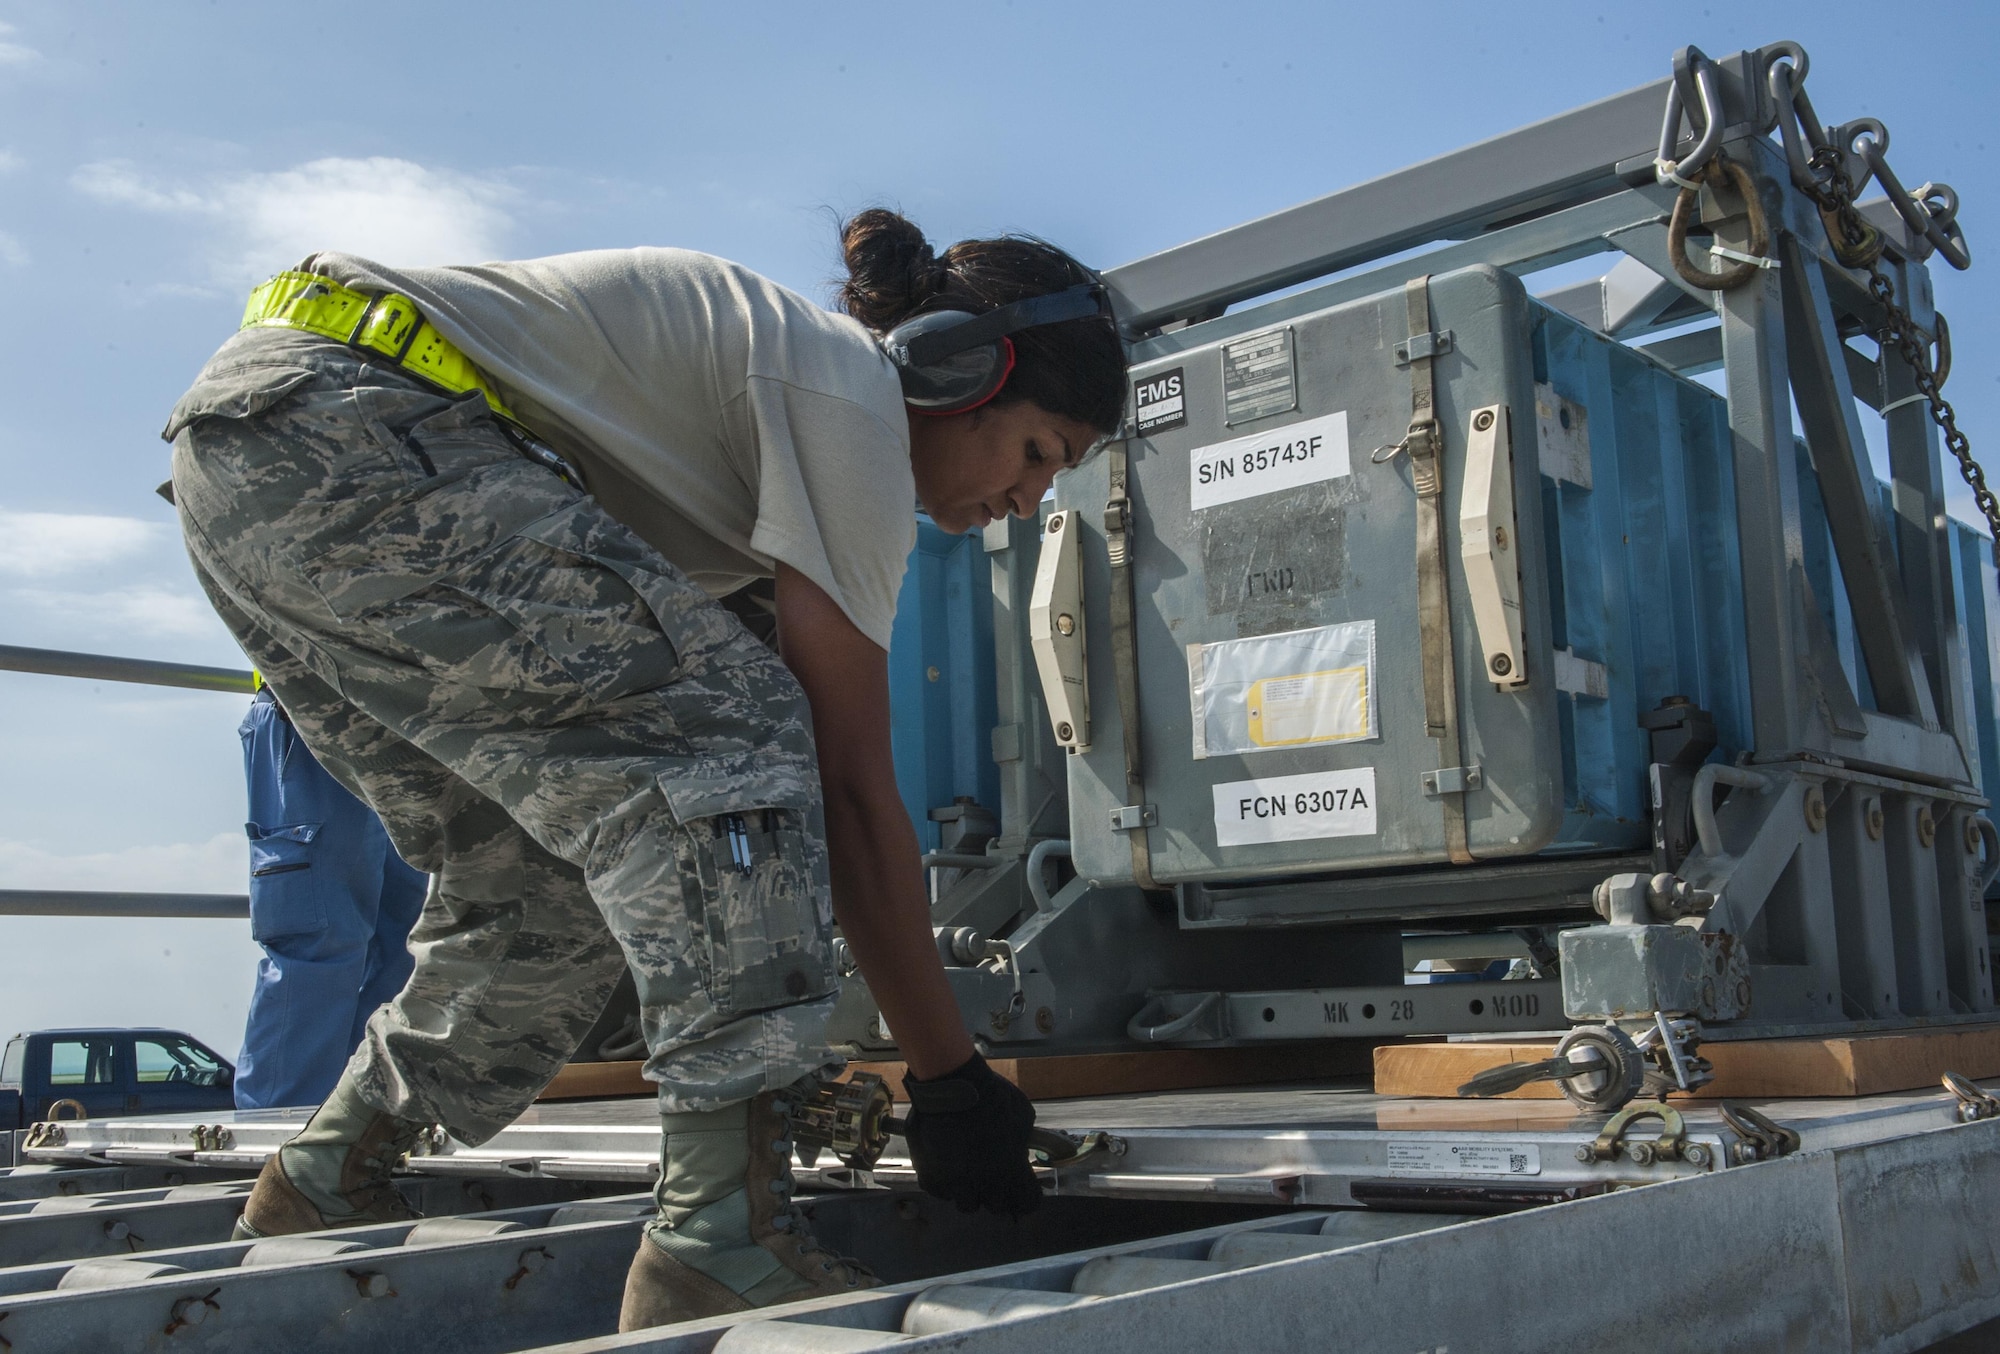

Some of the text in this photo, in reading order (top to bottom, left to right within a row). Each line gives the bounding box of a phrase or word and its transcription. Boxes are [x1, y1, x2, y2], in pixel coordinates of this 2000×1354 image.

[1137, 375, 1181, 406] FMS
[1138, 411, 1184, 430] CASE NUMBER
[1198, 435, 1322, 485] S/N 85743F
[1248, 567, 1294, 597] FWD
[1239, 787, 1369, 820] FCN 6307A
[1323, 993, 1540, 1024] MK 28 MOD
